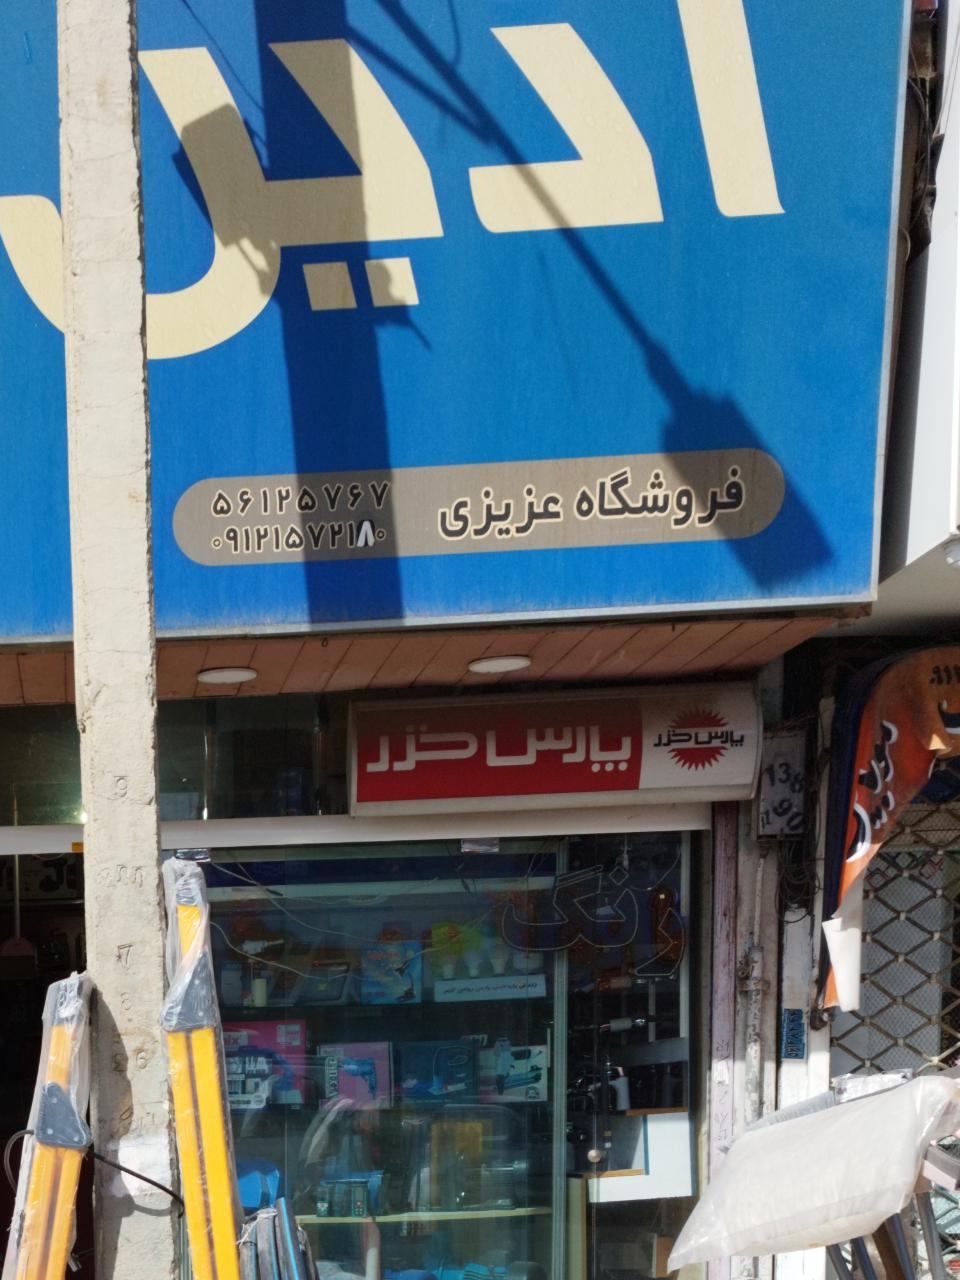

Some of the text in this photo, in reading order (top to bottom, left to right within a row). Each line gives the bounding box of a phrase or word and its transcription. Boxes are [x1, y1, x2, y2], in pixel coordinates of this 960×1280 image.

[211, 480, 390, 518] ۵۶۱۲۵۷۶۷
[439, 466, 744, 540] فروشگاه عزیزی
[366, 722, 633, 773] پارس خزر
[653, 729, 745, 747] پارس خزر
[501, 864, 686, 977] رنگ
